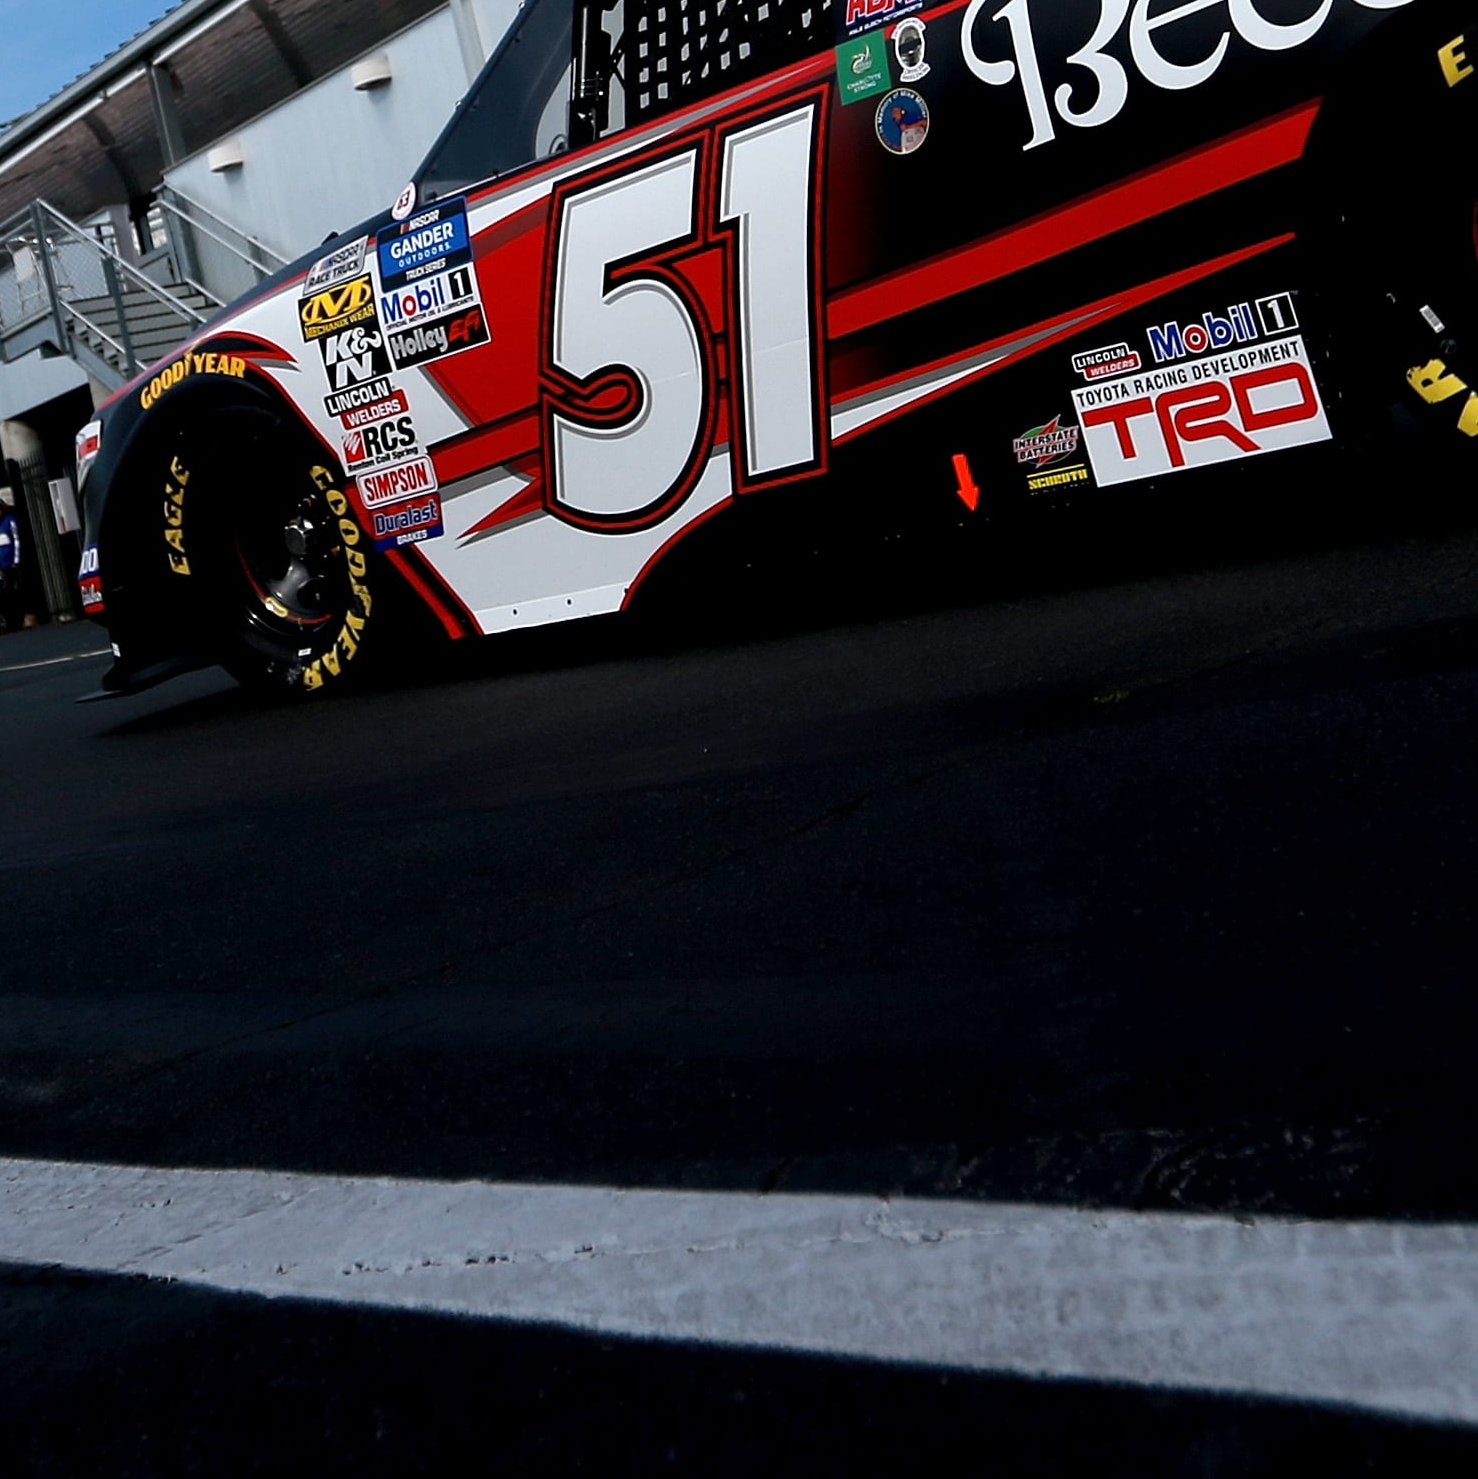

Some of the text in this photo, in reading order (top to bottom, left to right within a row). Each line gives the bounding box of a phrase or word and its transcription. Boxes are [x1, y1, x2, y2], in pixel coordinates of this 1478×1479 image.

[390, 221, 455, 259] GANDER
[398, 242, 452, 267] OUTDOORS
[308, 260, 358, 286] RACE TRUCK
[381, 271, 466, 325] Mobil 1
[551, 102, 818, 519] 51
[390, 325, 449, 360] Holley
[1146, 299, 1286, 363] Mobil 1
[1075, 348, 1127, 369] LINCOLN
[1076, 340, 1300, 408] TOYOTA RACING DEVELOPMENT
[1089, 358, 1137, 378] WELDERS
[139, 348, 246, 410] GOODYEAR
[327, 380, 390, 414] LINCOLN
[346, 399, 401, 427] WELDERS
[1081, 362, 1318, 468] TRD
[363, 416, 415, 458] RCS
[1015, 429, 1075, 448] INTERSTATE
[1020, 441, 1074, 460] BATTERIES
[365, 462, 428, 501] SIMPSON
[163, 454, 192, 577] EAGLE
[374, 499, 438, 536] Duralast
[302, 464, 372, 691] GOODYEAR
